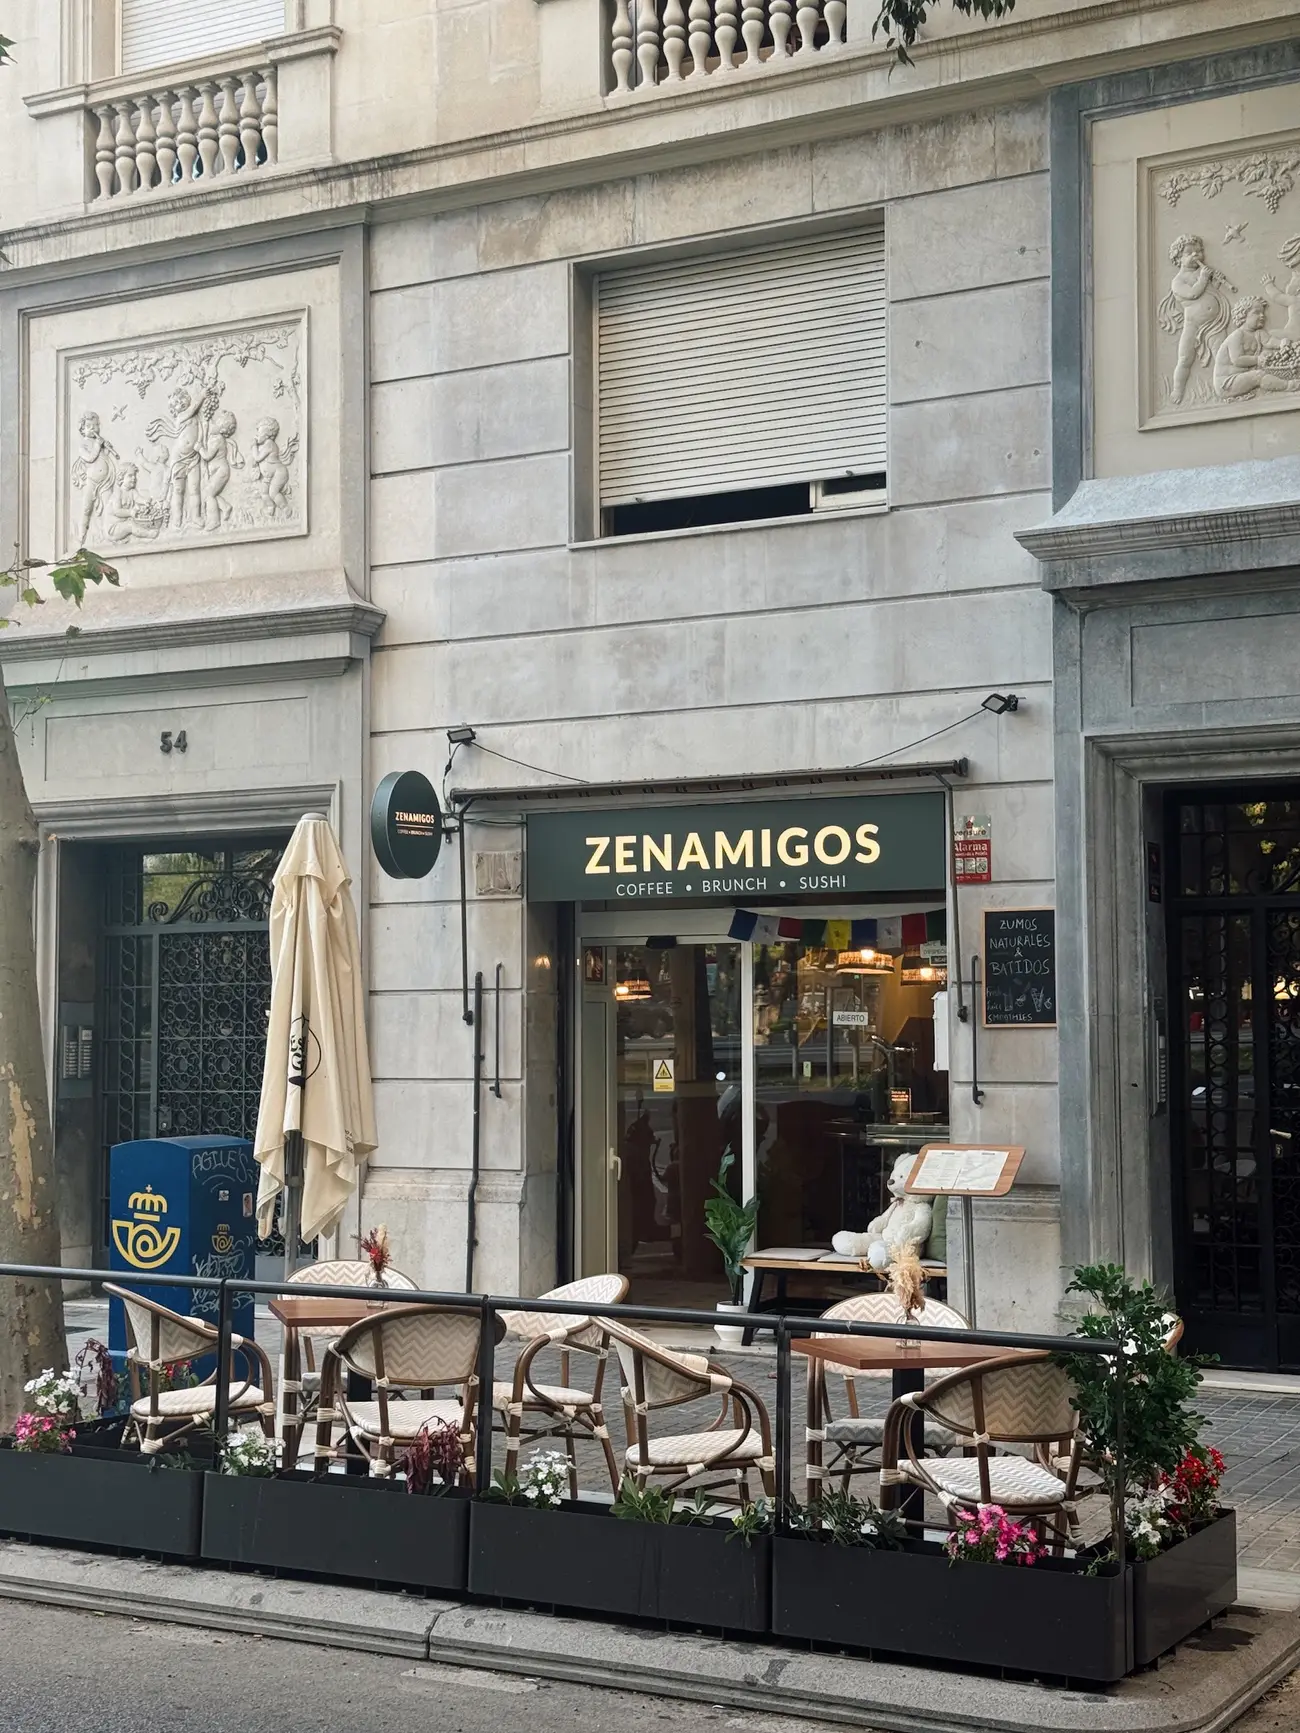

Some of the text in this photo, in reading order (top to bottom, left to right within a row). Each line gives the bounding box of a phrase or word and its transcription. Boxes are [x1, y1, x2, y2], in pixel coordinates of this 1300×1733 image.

[160, 730, 187, 753] 54
[394, 811, 435, 824] ZENAMIGOS
[584, 823, 881, 875] ZENAMIGOS
[616, 875, 847, 897] COFFEE BRUNCH SUSHI
[999, 917, 1038, 931] ZUMOS
[989, 933, 1051, 950] NATURALES
[1014, 947, 1023, 957] &
[989, 958, 1050, 977] BATIDOS
[836, 1014, 865, 1023] ABIERTO
[987, 1012, 1033, 1024] SMOOTHIES
